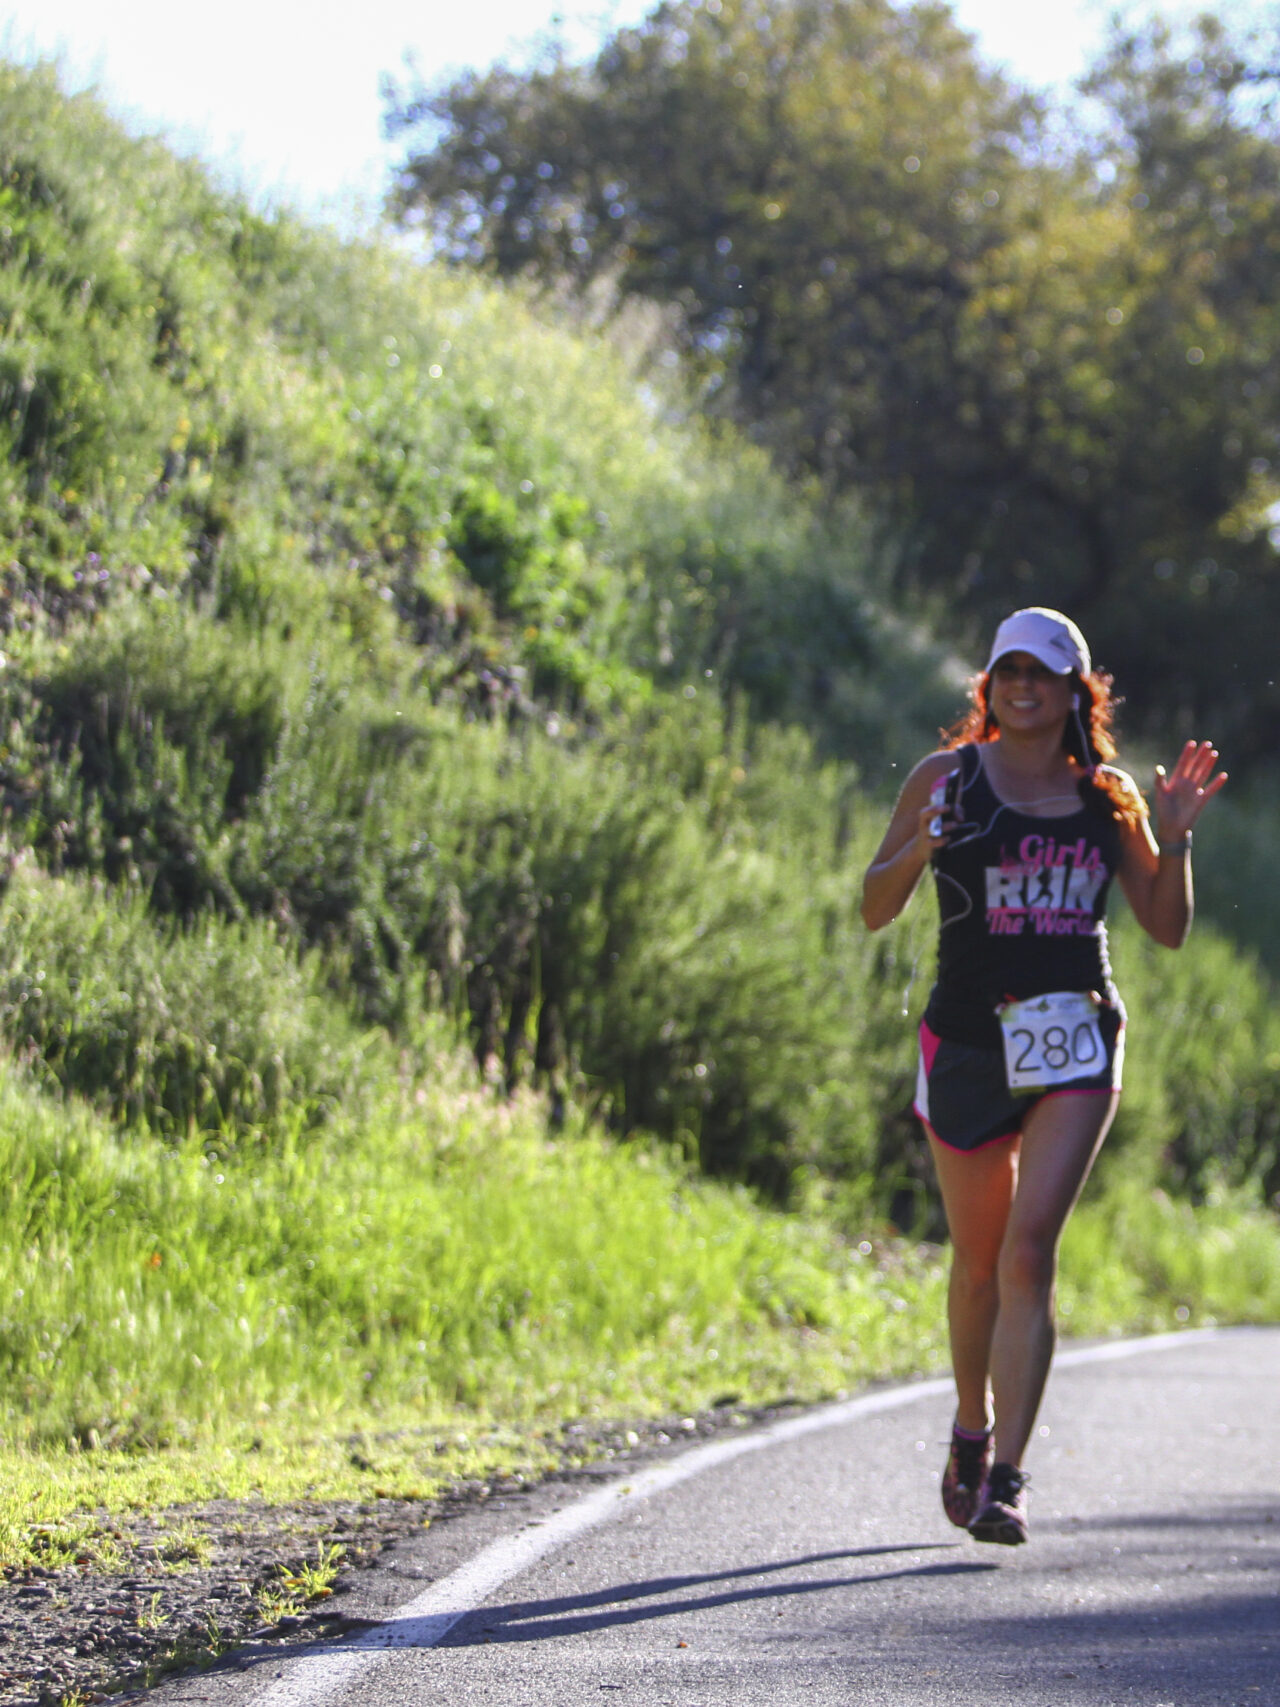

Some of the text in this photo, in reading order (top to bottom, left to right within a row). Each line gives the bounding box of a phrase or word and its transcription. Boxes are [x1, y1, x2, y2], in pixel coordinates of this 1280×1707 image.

[1019, 834, 1103, 877] Girls
[985, 866, 1104, 911] RUN
[986, 908, 1025, 934] The
[1011, 1022, 1098, 1073] 280
